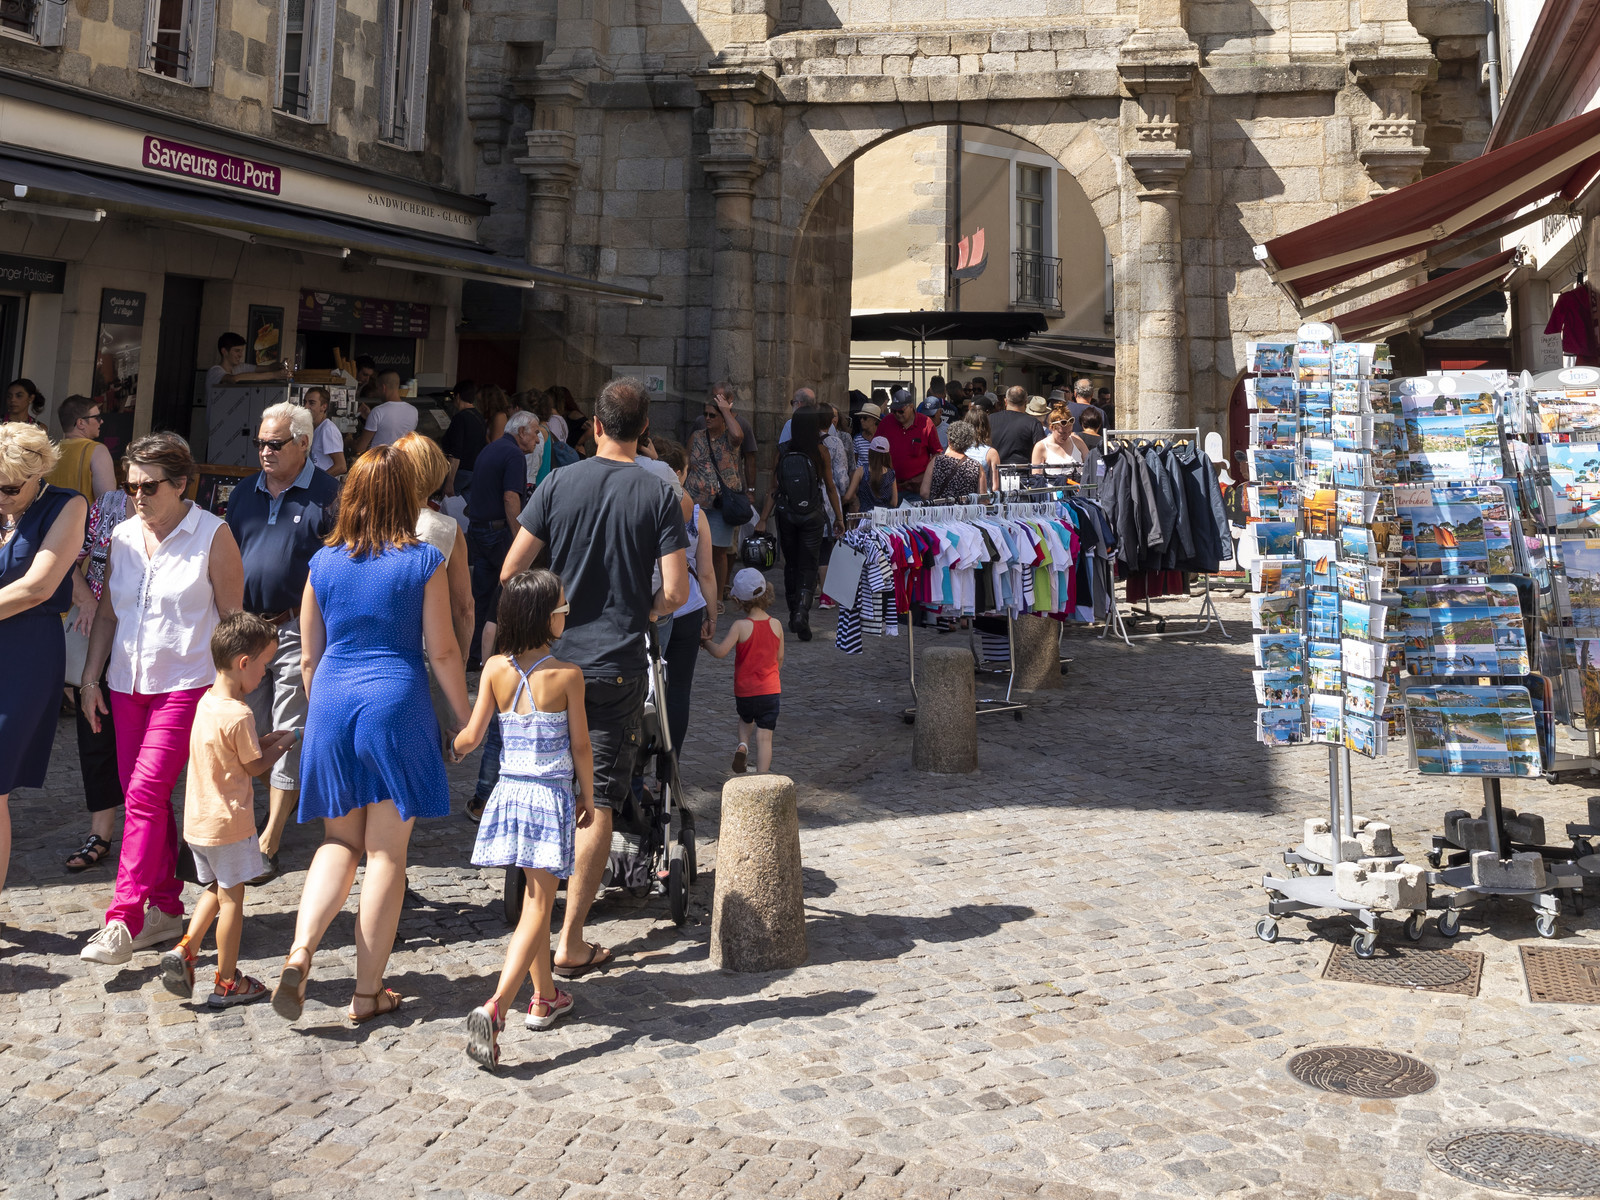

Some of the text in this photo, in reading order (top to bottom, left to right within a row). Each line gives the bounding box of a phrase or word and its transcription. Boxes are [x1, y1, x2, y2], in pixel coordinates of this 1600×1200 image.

[148, 139, 275, 191] Saveurs du Port
[367, 193, 435, 218] SANDWICHERIE
[442, 210, 473, 226] GLACES
[23, 266, 55, 284] Pâtissier
